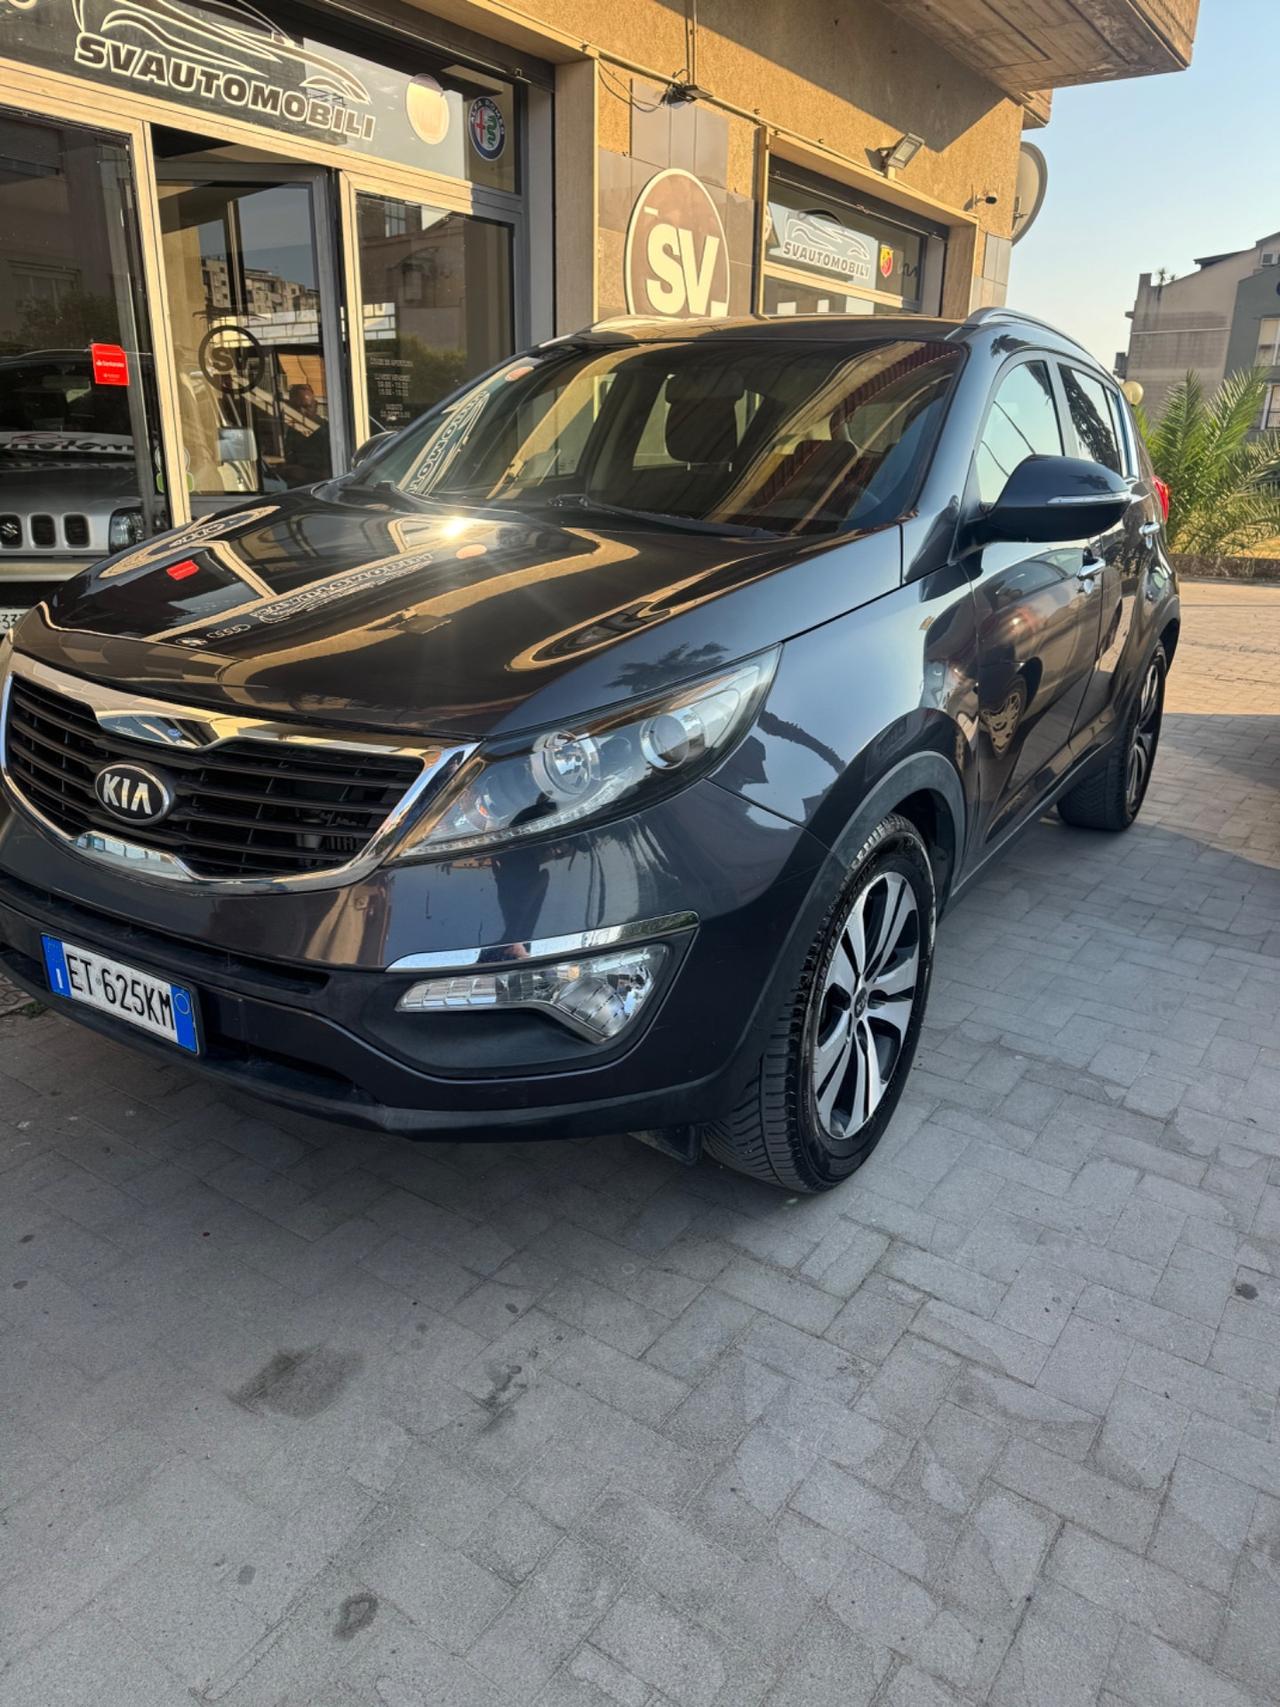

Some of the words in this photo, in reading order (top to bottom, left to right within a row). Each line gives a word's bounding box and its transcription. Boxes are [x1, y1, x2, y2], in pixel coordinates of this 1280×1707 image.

[74, 32, 376, 141] SVAUTOMOBILI
[646, 223, 720, 316] SV
[783, 239, 872, 279] SVAUTOMOBILI
[103, 773, 153, 815] KIA
[65, 953, 93, 996] ET
[101, 967, 176, 1032] 625KM
